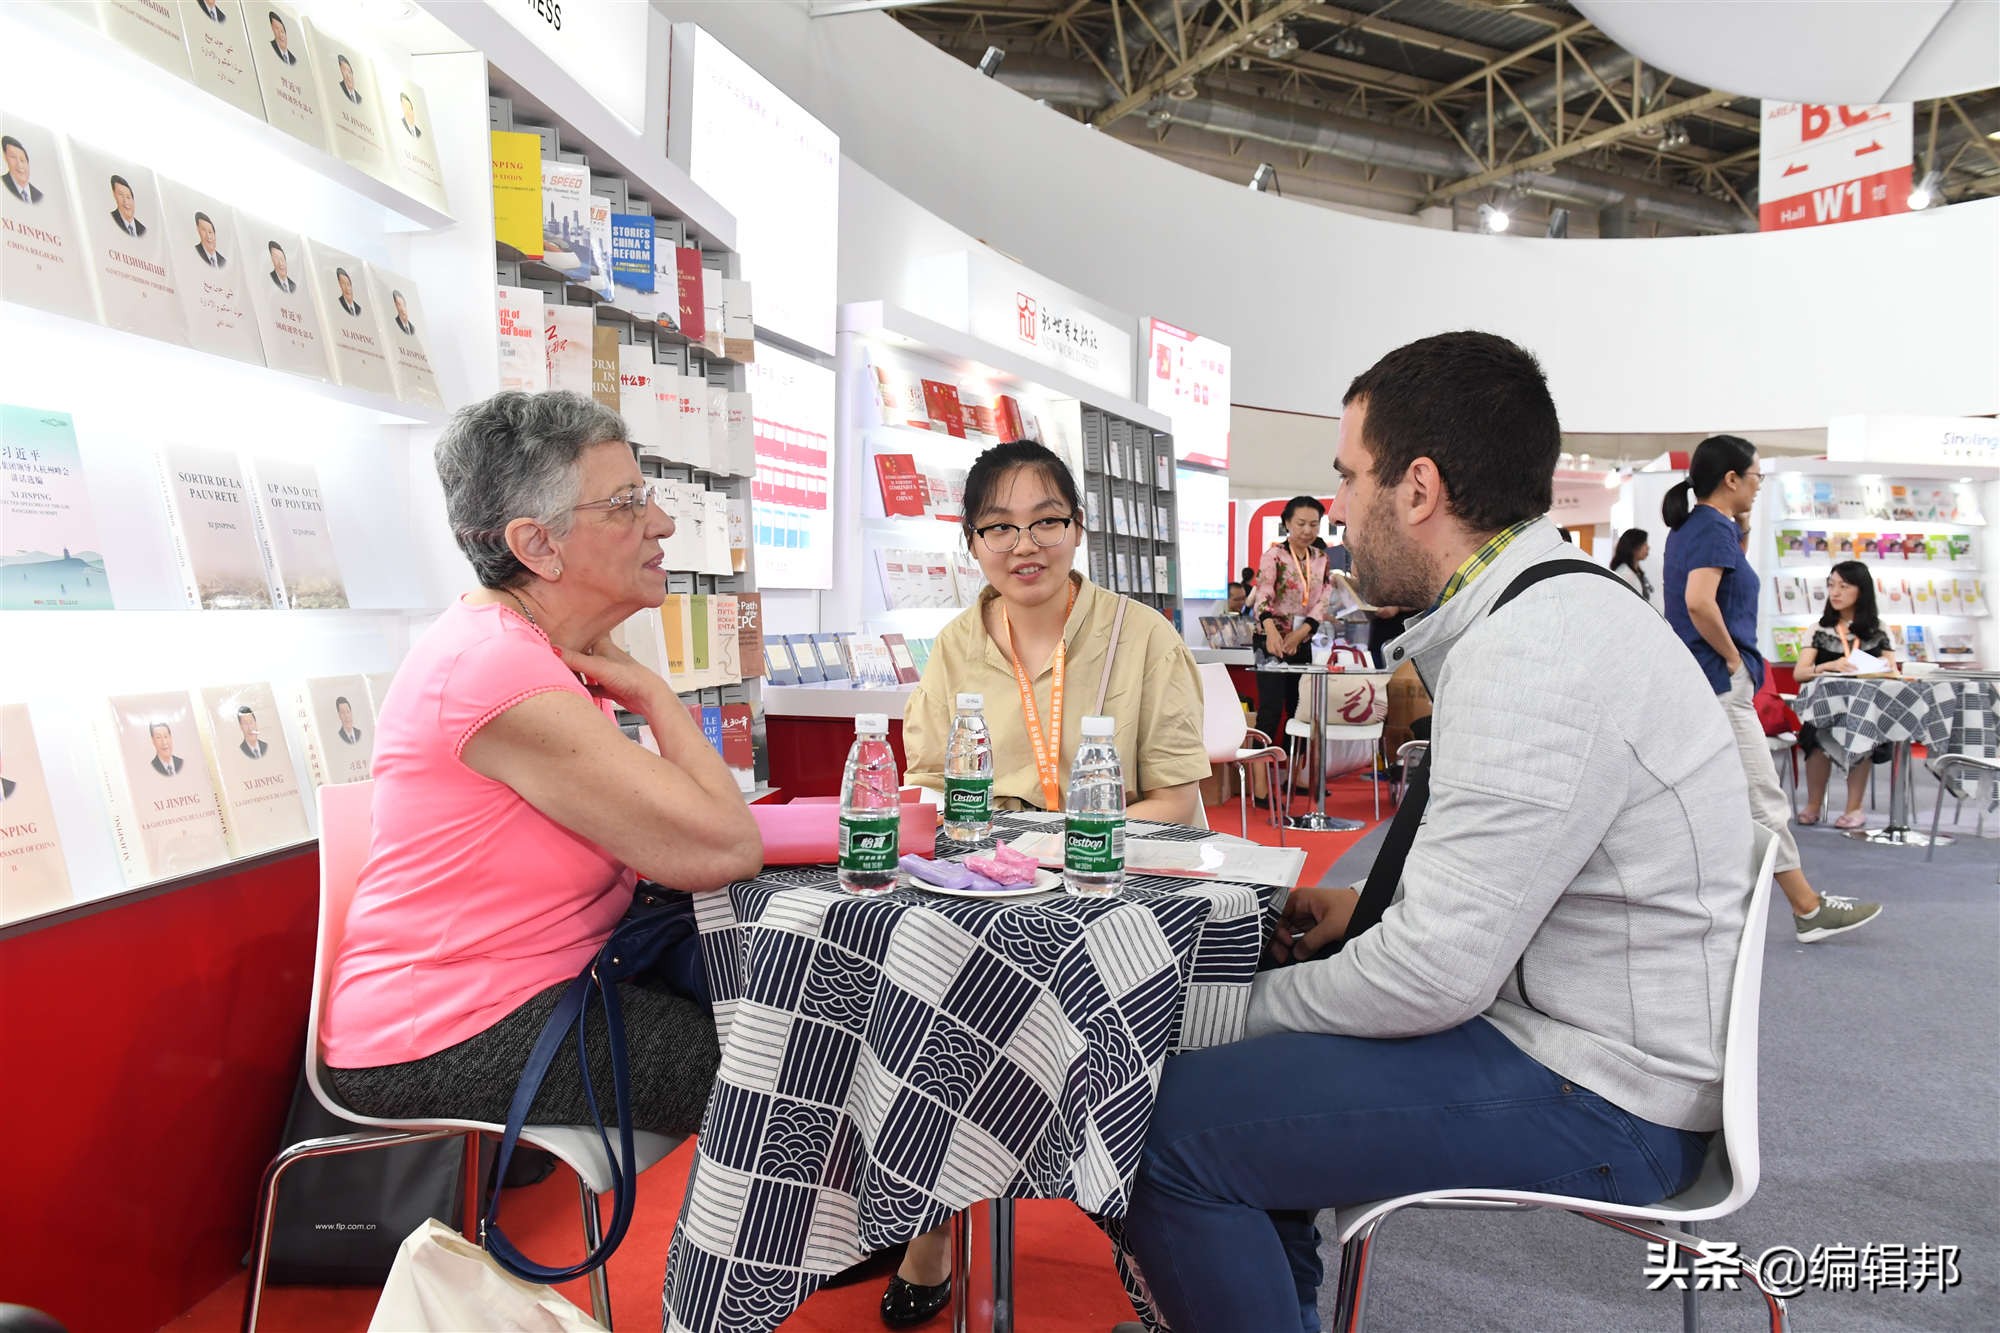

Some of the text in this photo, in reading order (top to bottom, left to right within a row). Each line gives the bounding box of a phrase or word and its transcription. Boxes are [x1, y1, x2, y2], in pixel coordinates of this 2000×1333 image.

[550, 175, 583, 189] SPEED
[1780, 205, 1806, 224] Hall
[1812, 180, 1863, 223] W1
[1, 216, 62, 247] XI JINPING
[612, 226, 651, 239] STORIES
[612, 237, 651, 250] CHINA'S
[613, 248, 651, 261] REFORM
[511, 310, 520, 319] of
[500, 317, 514, 328] the
[513, 328, 532, 338] Boat
[603, 372, 616, 382] IN
[2, 445, 42, 463] 习近平
[178, 471, 242, 490] SORTIR DE LA
[21, 491, 52, 502] JINPING
[267, 483, 319, 499] UP AND OUT
[271, 497, 324, 512] OF POVERTY
[741, 601, 758, 613] Path
[704, 727, 718, 735] OF
[243, 774, 285, 791] XI JINPING
[154, 793, 201, 812] XI JINPING
[25, 845, 34, 853] OF
[35, 841, 56, 851] CHINA
